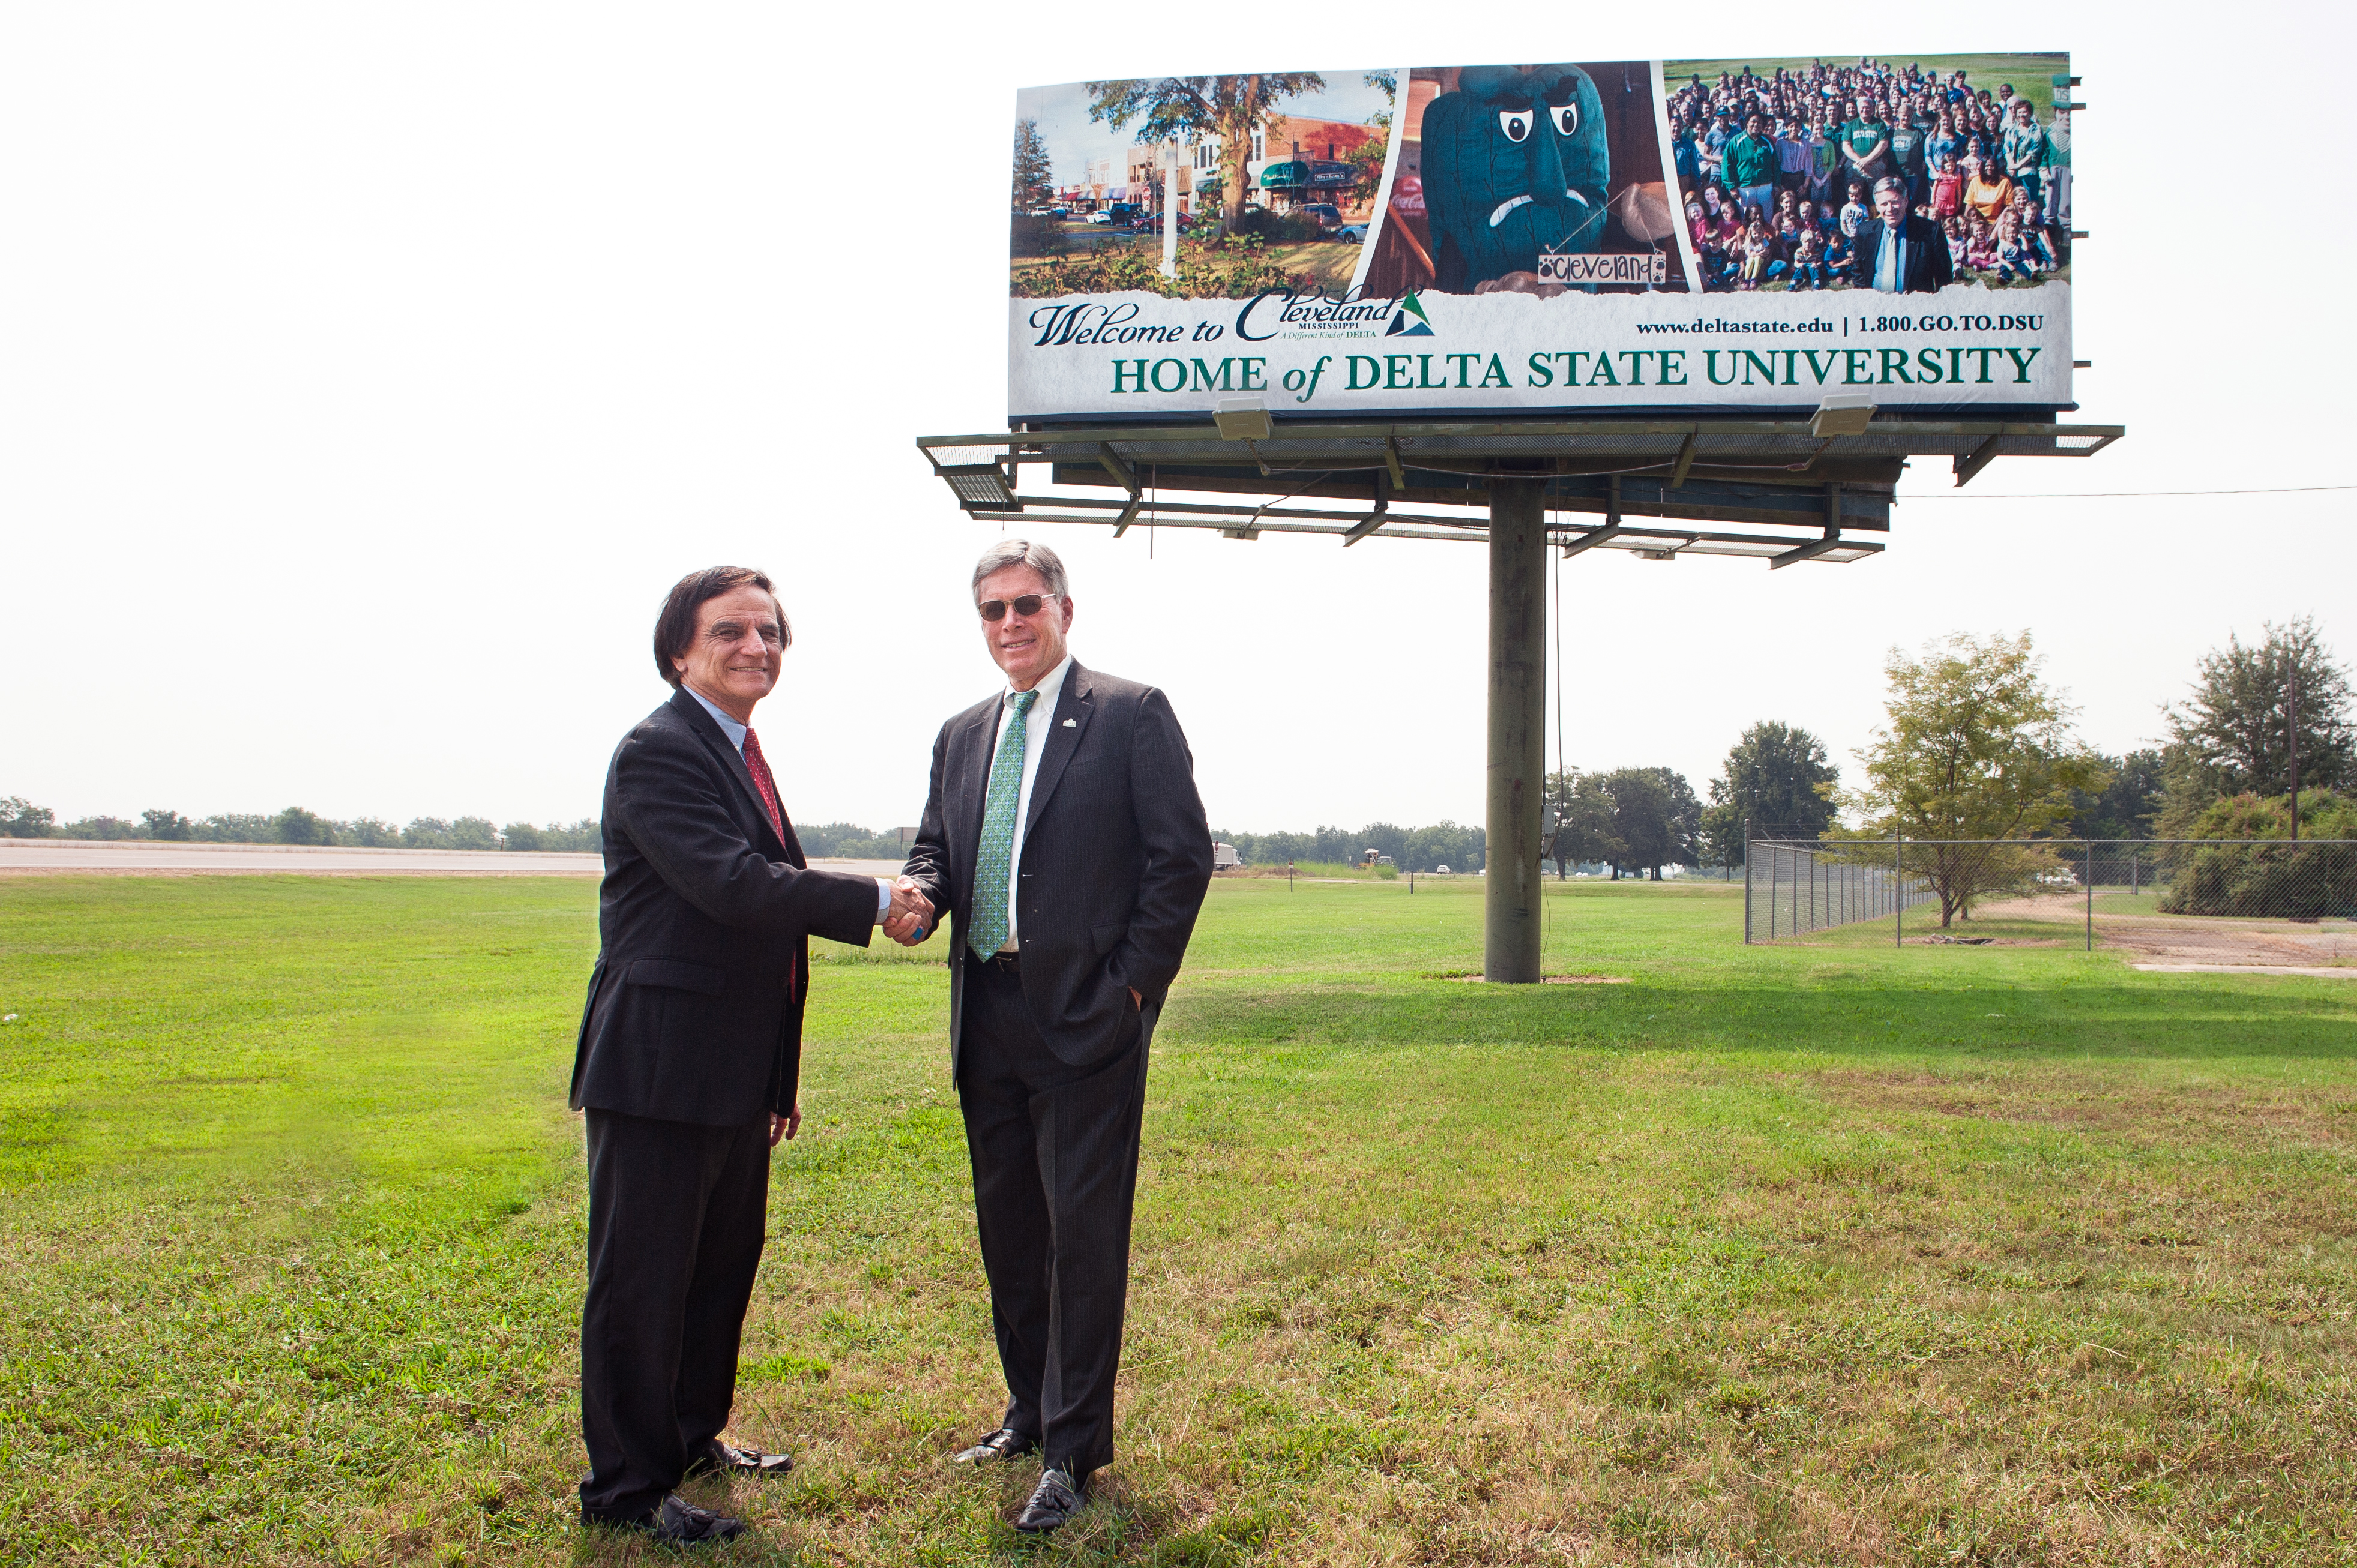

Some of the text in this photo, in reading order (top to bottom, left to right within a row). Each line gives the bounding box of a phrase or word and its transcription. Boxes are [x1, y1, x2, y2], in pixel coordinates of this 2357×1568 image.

[1029, 284, 1424, 346] Welcome to Cleveland
[1636, 317, 1833, 334] www.deltastate.edu
[1859, 315, 2044, 332] 1.800.GO.TO.DSU
[1288, 331, 1317, 341] Different
[1337, 331, 1344, 340] of
[1111, 348, 2041, 403] HOME of DELTA STATE UNIVERSITY
